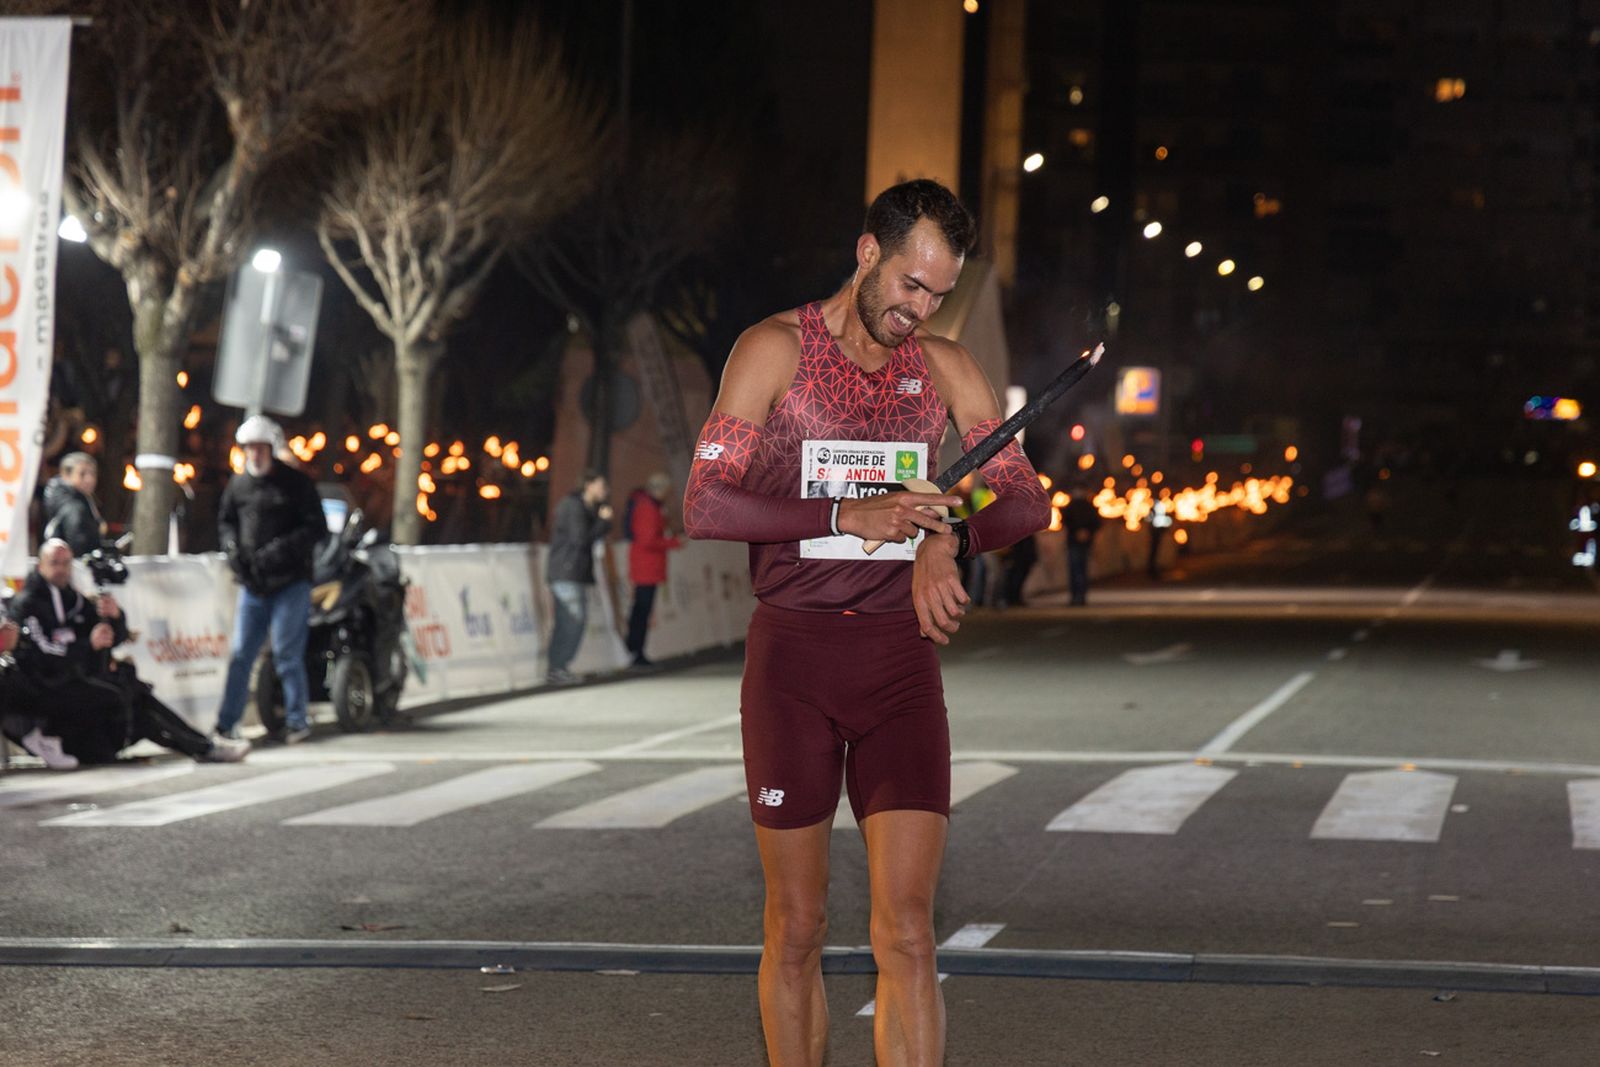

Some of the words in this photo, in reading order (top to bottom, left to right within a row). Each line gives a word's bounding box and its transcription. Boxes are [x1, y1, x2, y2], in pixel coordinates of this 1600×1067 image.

[832, 454, 869, 466] NOCHE
[872, 455, 886, 466] DE
[845, 466, 886, 481] ANTÓN
[757, 787, 785, 807] NB
